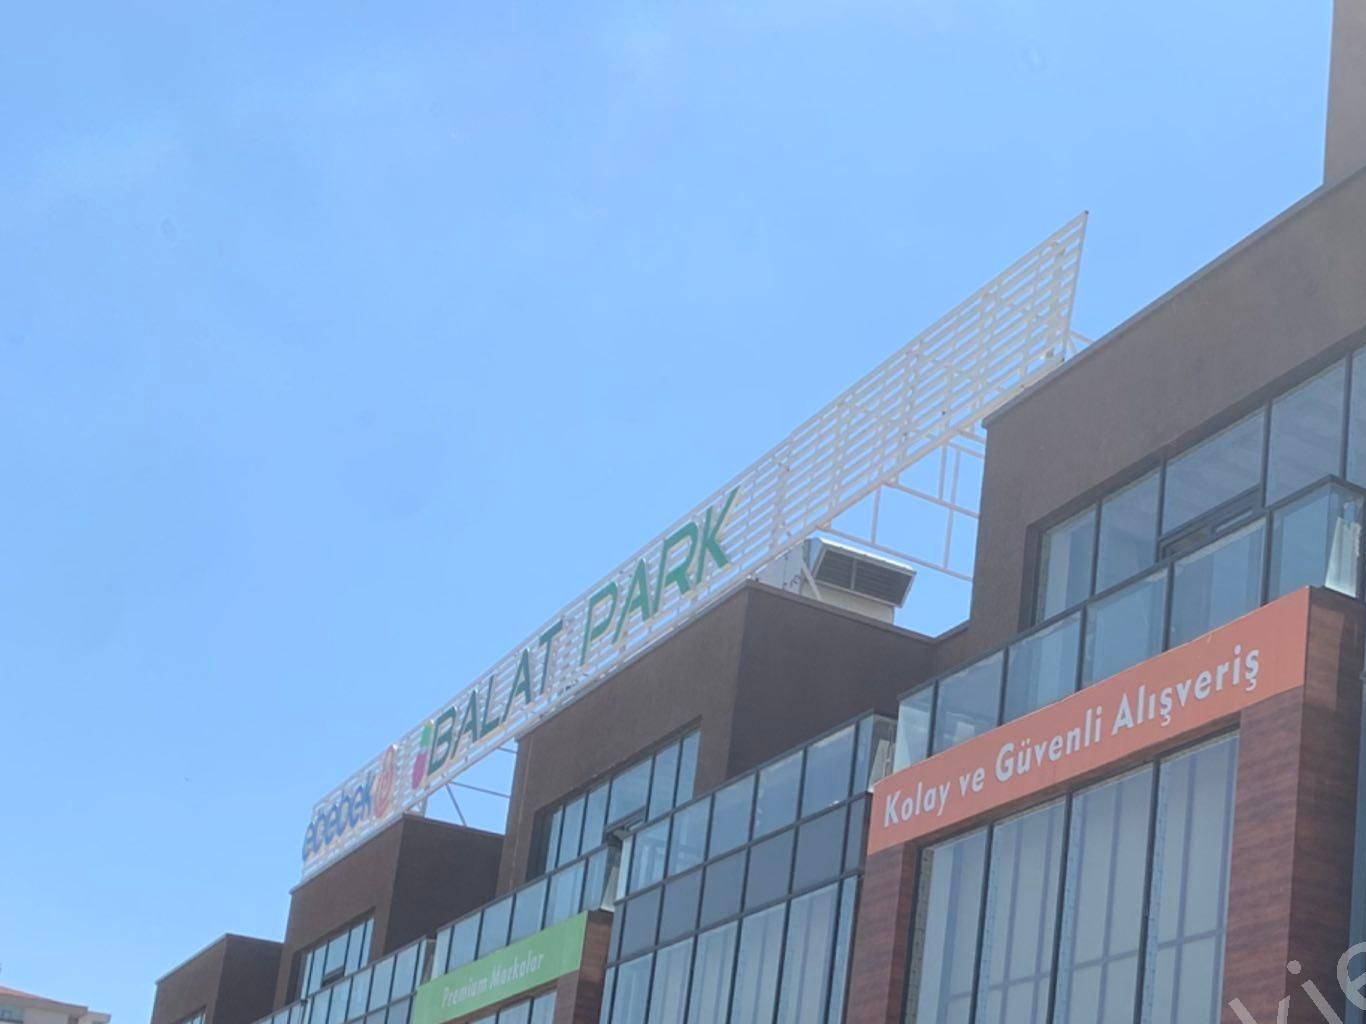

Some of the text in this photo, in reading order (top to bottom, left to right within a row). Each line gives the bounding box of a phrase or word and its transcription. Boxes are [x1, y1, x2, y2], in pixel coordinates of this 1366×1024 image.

[427, 485, 740, 777] BALAT PARK
[883, 643, 1260, 828] Kolay ve Güvenli Alışveriş
[441, 976, 487, 1009] Premium
